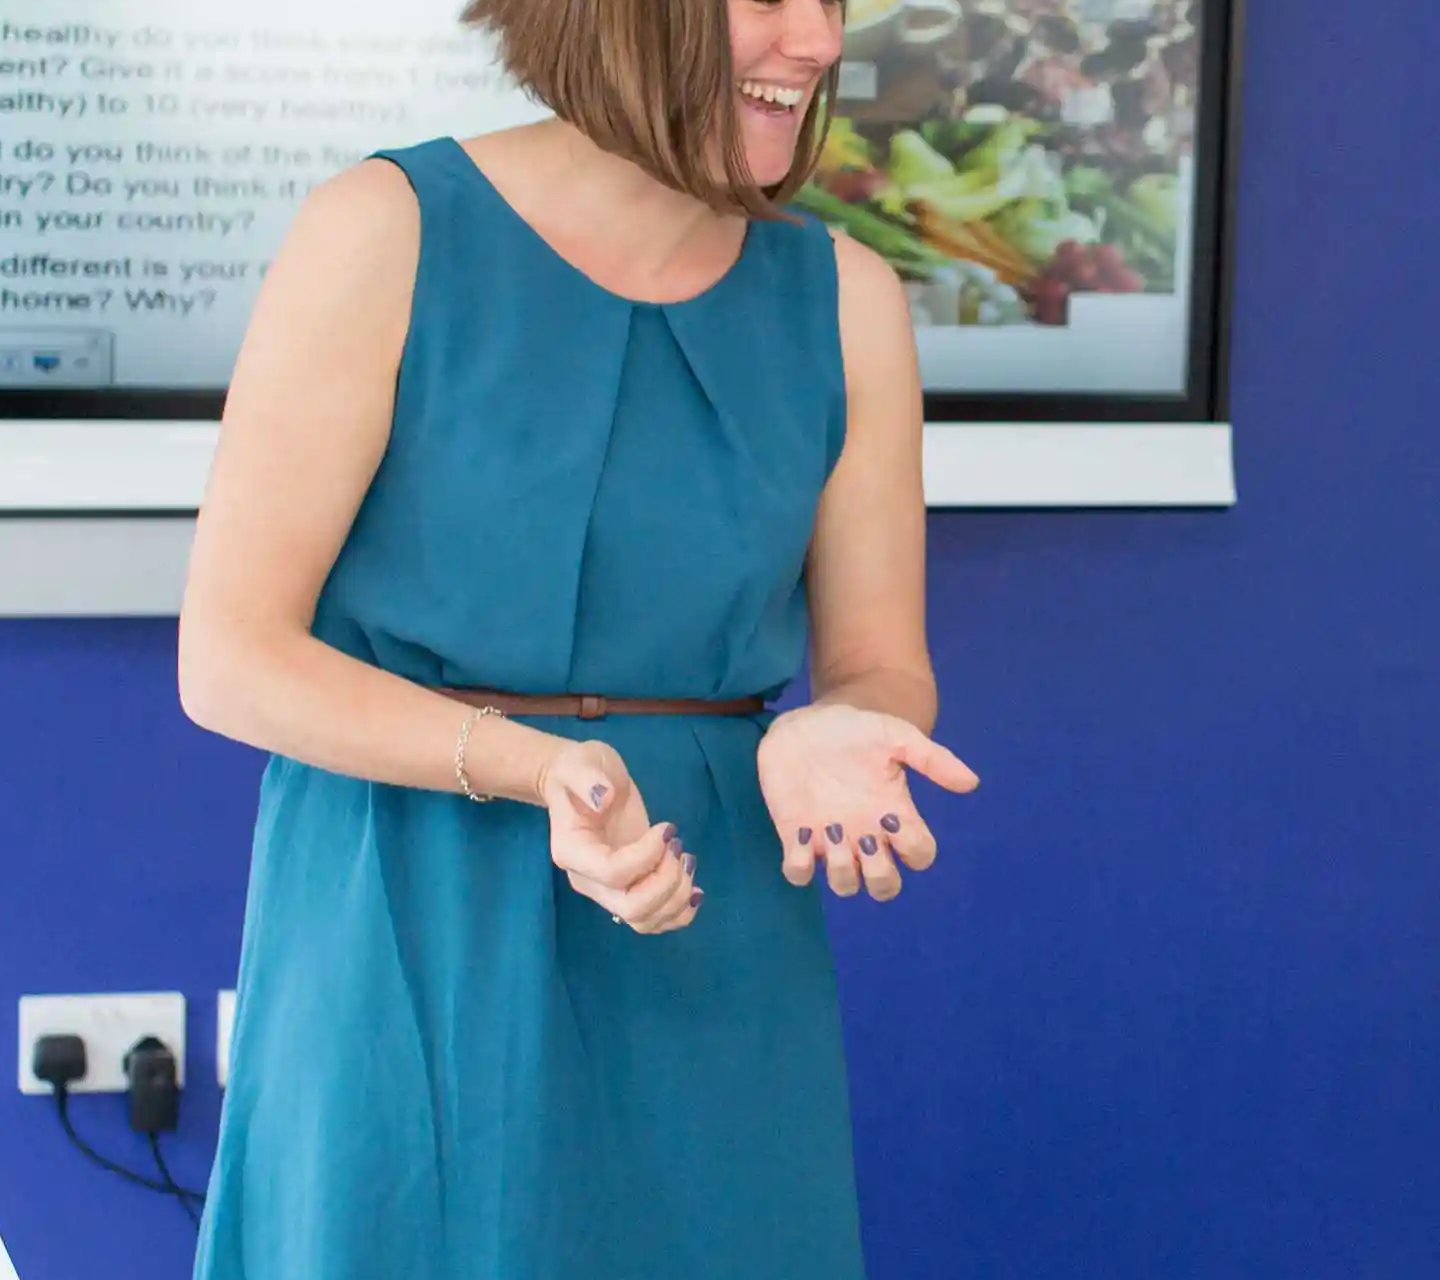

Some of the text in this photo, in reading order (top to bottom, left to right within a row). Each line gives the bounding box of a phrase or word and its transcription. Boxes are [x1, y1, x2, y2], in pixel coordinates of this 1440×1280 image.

[1, 21, 119, 49] healthy
[131, 22, 172, 46] do
[183, 26, 241, 51] you
[79, 56, 155, 80] Give
[162, 57, 183, 81] it
[193, 63, 215, 83] a
[97, 92, 130, 116] to
[143, 94, 179, 116] 10
[190, 95, 267, 123] (very
[13, 136, 55, 163] do
[65, 143, 124, 166] you
[135, 140, 213, 166] think
[221, 143, 253, 166] of
[262, 143, 314, 167] the
[66, 170, 113, 197] Do
[123, 178, 180, 202] you
[192, 175, 273, 200] think
[278, 176, 297, 200] it
[34, 209, 109, 235] your
[116, 209, 257, 238] country?
[141, 254, 169, 279] is
[177, 259, 250, 285] your
[0, 287, 114, 313] home?
[124, 288, 220, 318] Why?
